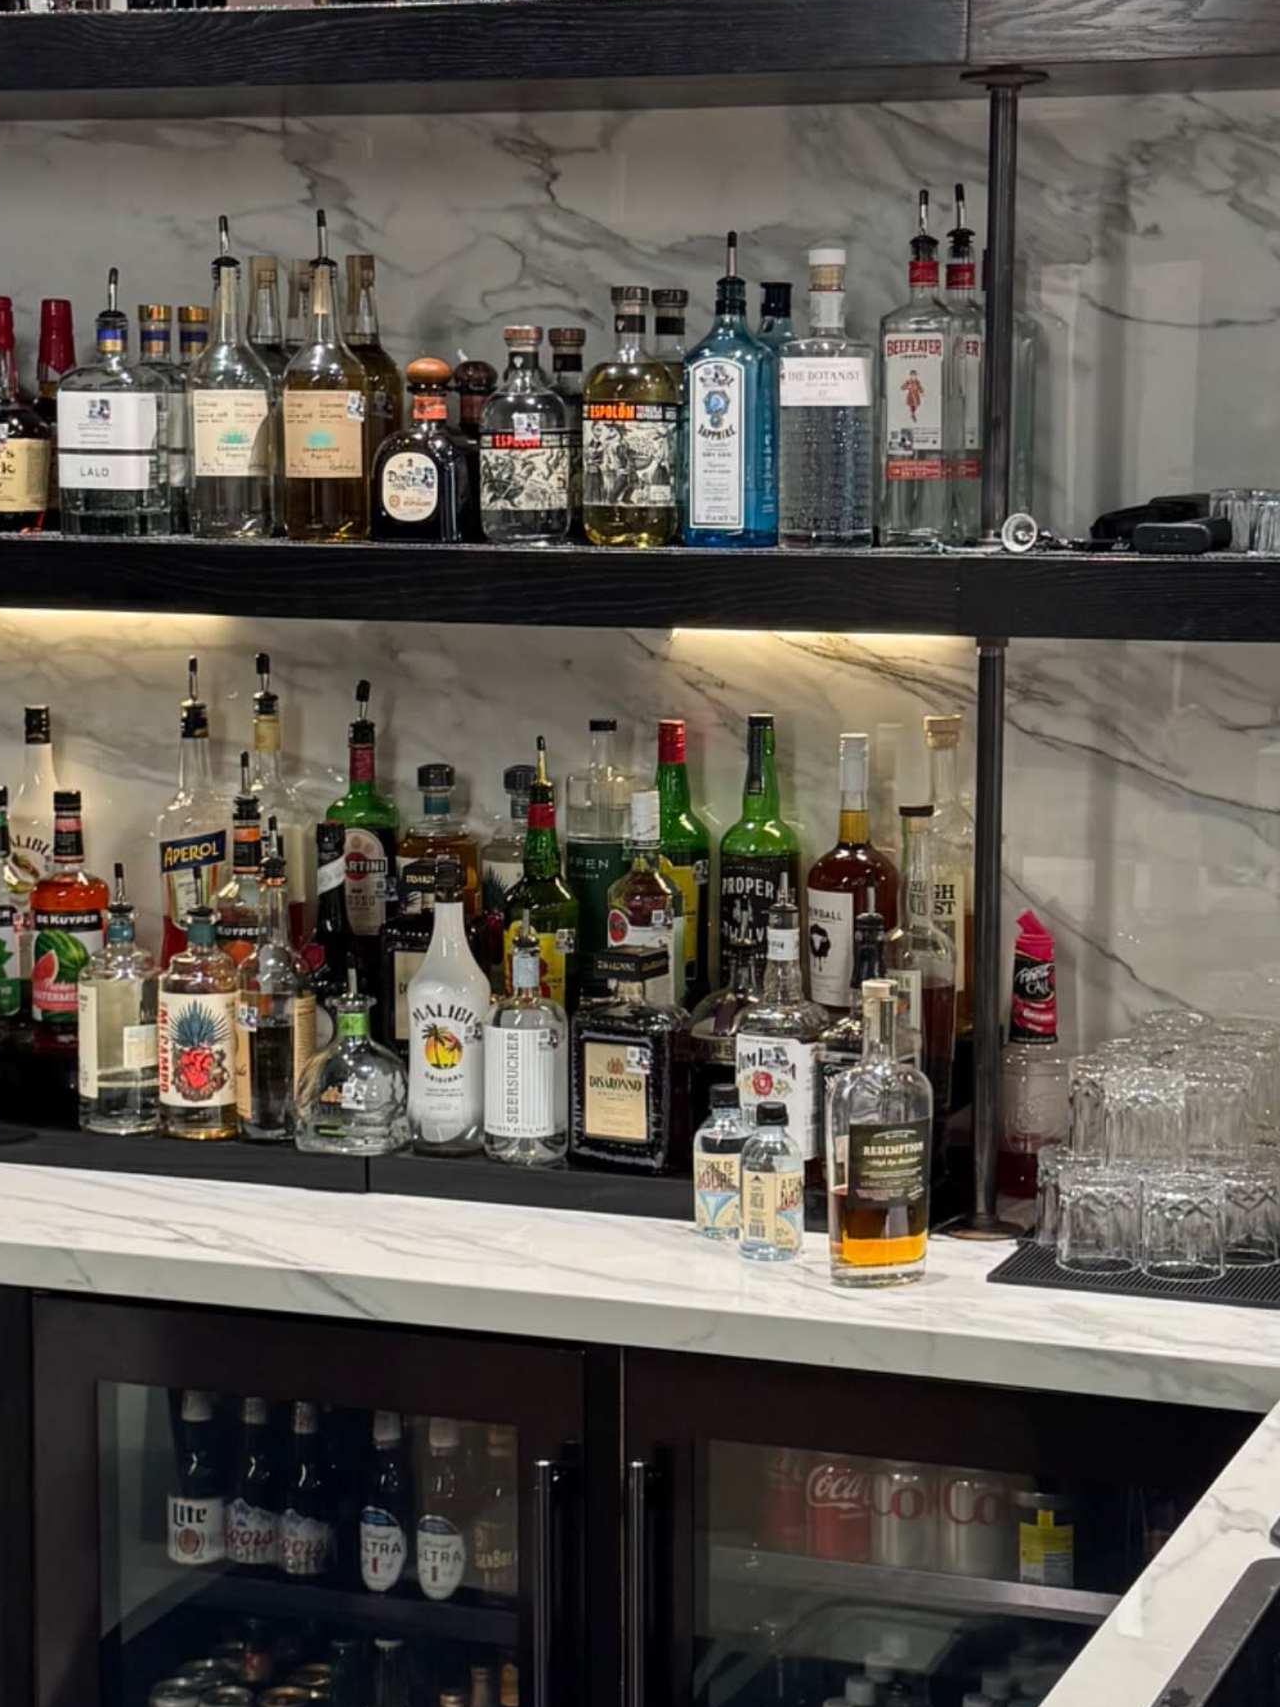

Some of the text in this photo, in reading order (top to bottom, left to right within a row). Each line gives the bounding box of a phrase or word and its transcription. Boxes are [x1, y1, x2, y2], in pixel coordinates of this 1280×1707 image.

[886, 339, 943, 357] BEEFEATER
[787, 370, 861, 382] THE BOTANIST
[79, 465, 110, 479] LALO
[163, 841, 221, 869] APEROL
[345, 859, 386, 873] ARTINI
[721, 875, 775, 899] PROPER
[49, 913, 99, 925] KUYPER
[424, 1072, 465, 1084] ORIGINAL
[506, 1032, 519, 1125] SEERSUCKER
[588, 1074, 643, 1093] DISARONNO
[863, 1142, 924, 1157] REDEMPTION
[173, 1502, 208, 1527] Lite
